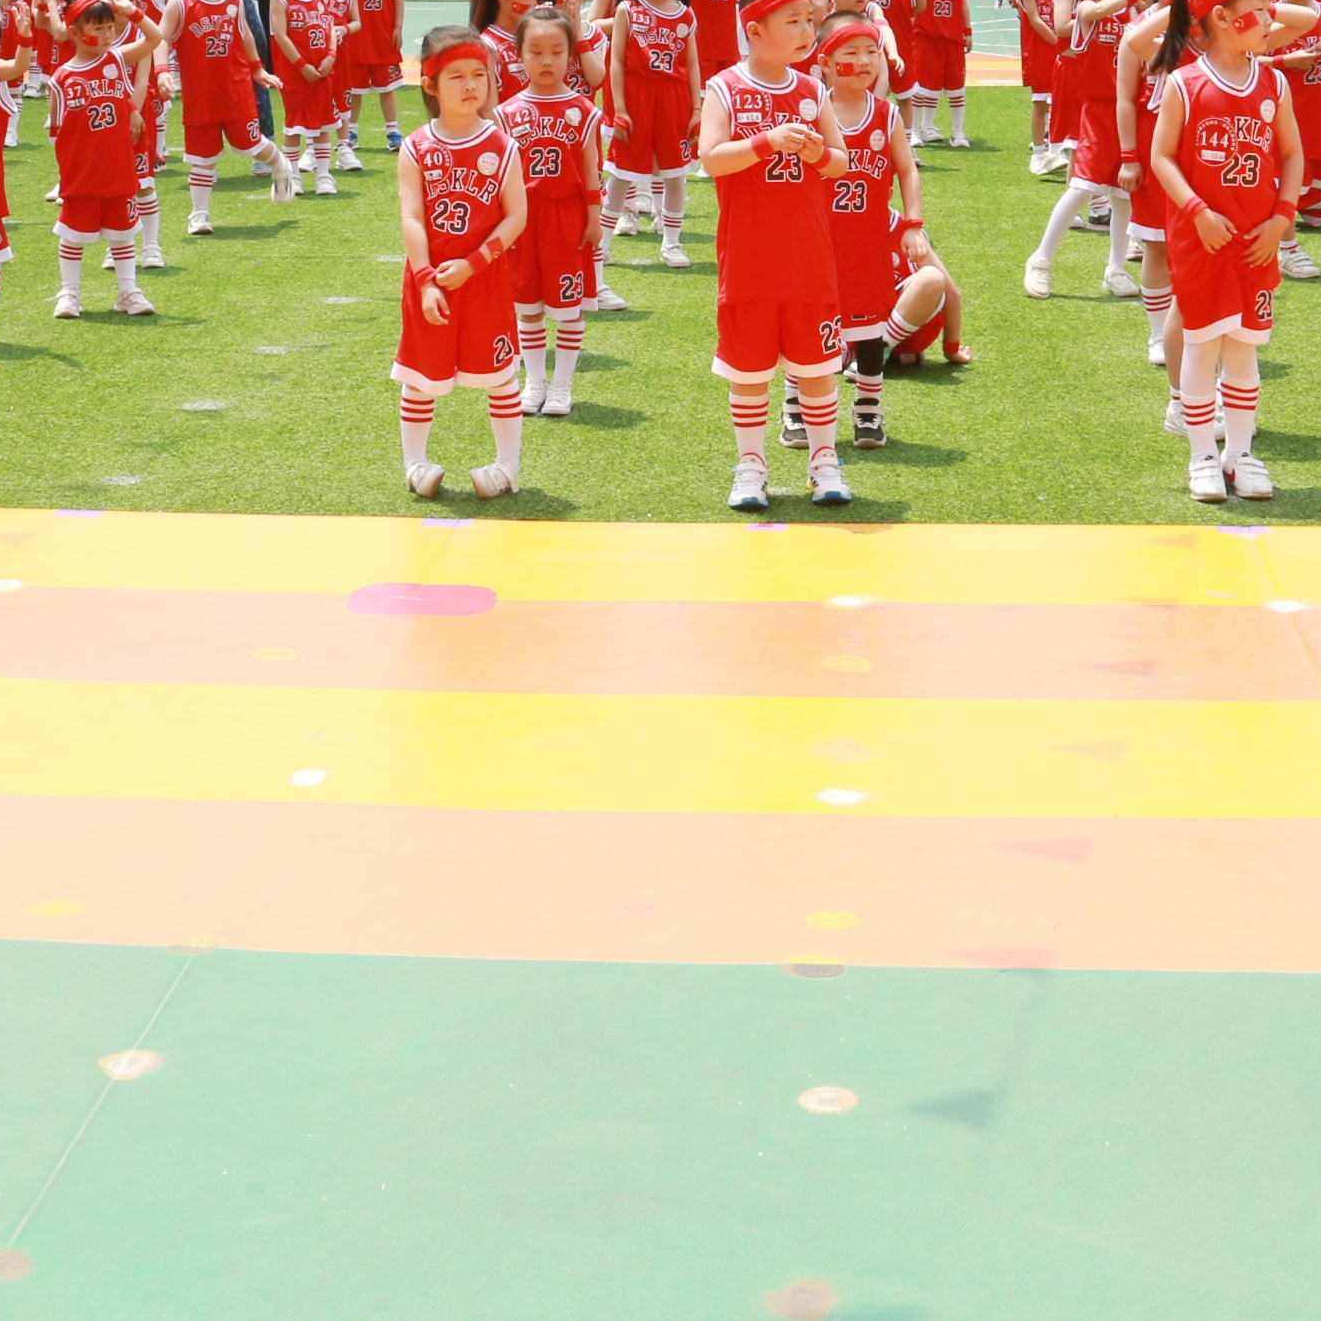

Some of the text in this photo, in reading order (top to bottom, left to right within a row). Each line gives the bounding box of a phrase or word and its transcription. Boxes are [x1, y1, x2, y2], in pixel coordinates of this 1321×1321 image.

[291, 11, 304, 21] 33
[631, 11, 651, 25] 133
[933, 0, 952, 17] 23
[1098, 21, 1118, 34] 145
[205, 37, 229, 58] 23
[308, 30, 327, 49] 23
[649, 51, 675, 72] 23
[66, 86, 82, 100] 37
[89, 80, 125, 99] KLR
[734, 93, 763, 110] 123
[87, 103, 116, 131] 23
[1200, 131, 1229, 148] 144
[1228, 116, 1273, 153] KLR
[423, 151, 443, 168] 40
[529, 146, 561, 178] 23
[765, 152, 804, 183] 23
[847, 149, 887, 180] KLR
[1221, 152, 1261, 187] 23
[832, 180, 867, 213] 23
[431, 198, 471, 235] 23
